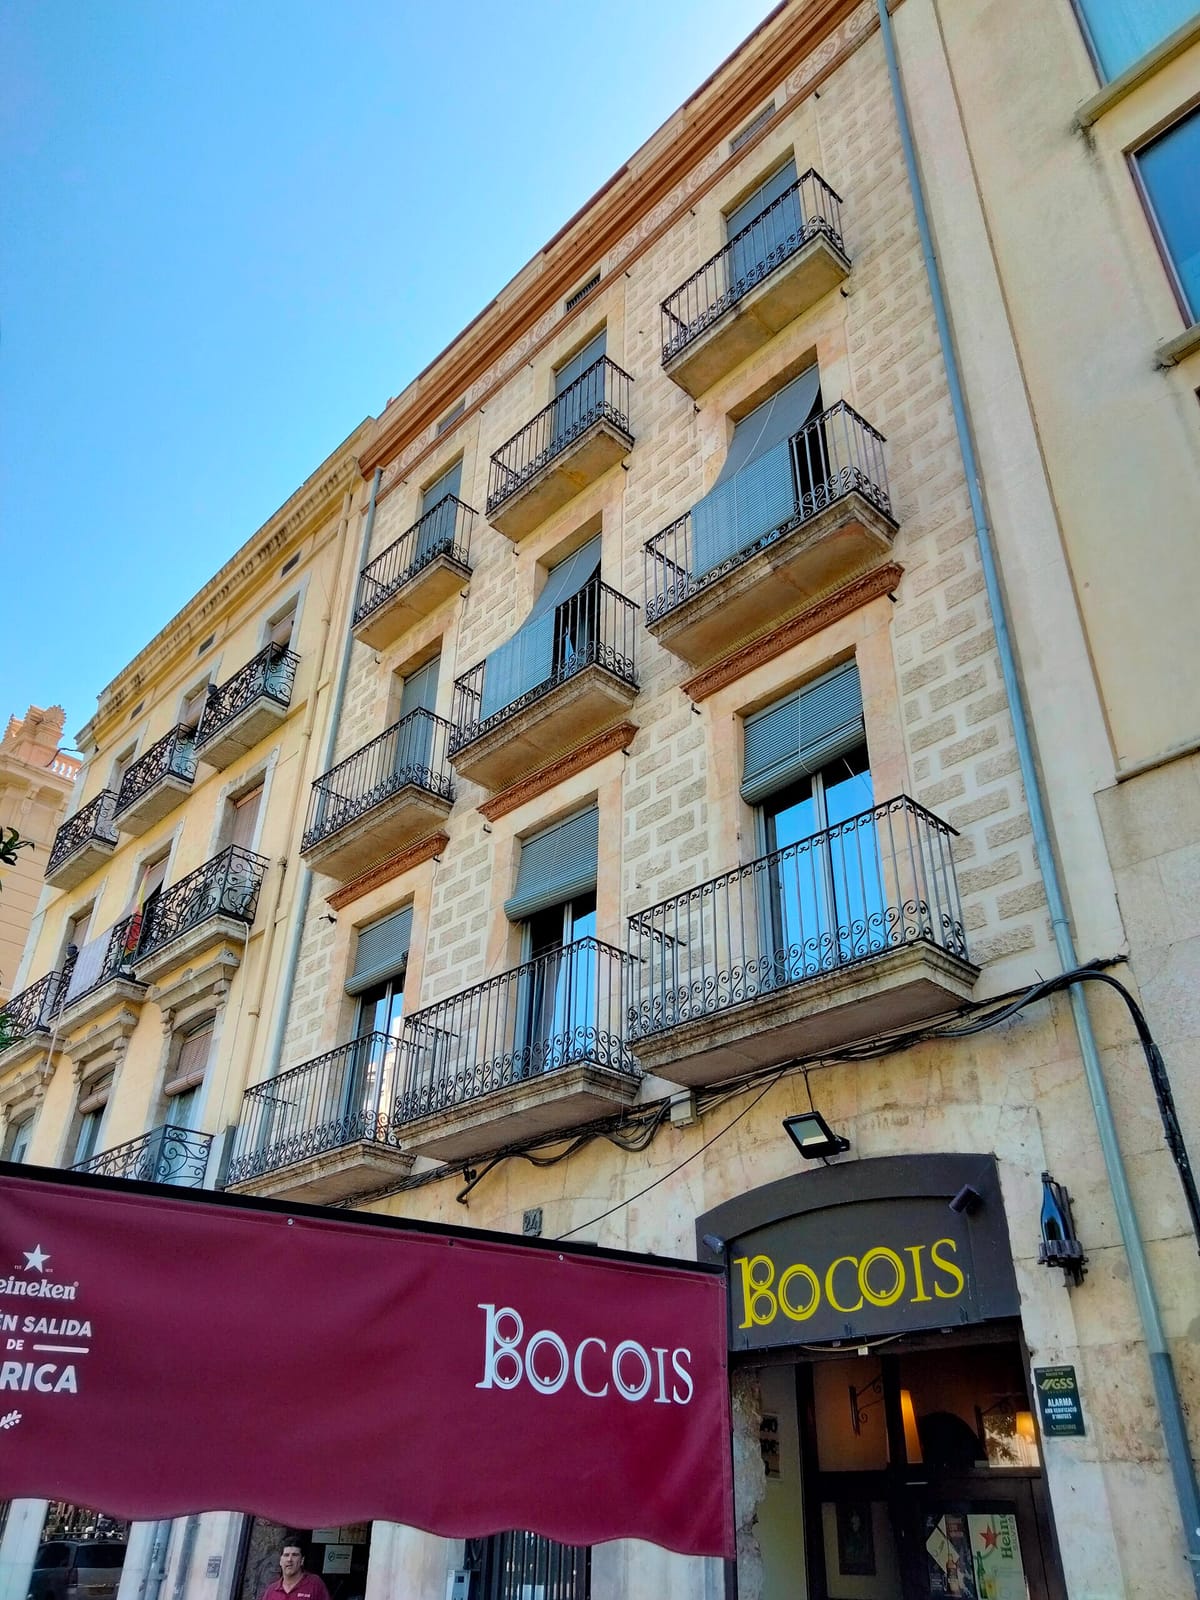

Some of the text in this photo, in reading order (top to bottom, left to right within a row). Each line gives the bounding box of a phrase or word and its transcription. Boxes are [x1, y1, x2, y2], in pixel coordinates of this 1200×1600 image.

[732, 1238, 965, 1329] BOCOIS
[22, 1316, 92, 1337] SALIDA
[6, 1339, 24, 1350] DE
[475, 1303, 694, 1405] BOCOIS
[0, 1361, 78, 1393] RICA
[1047, 1397, 1073, 1407] ALARMA
